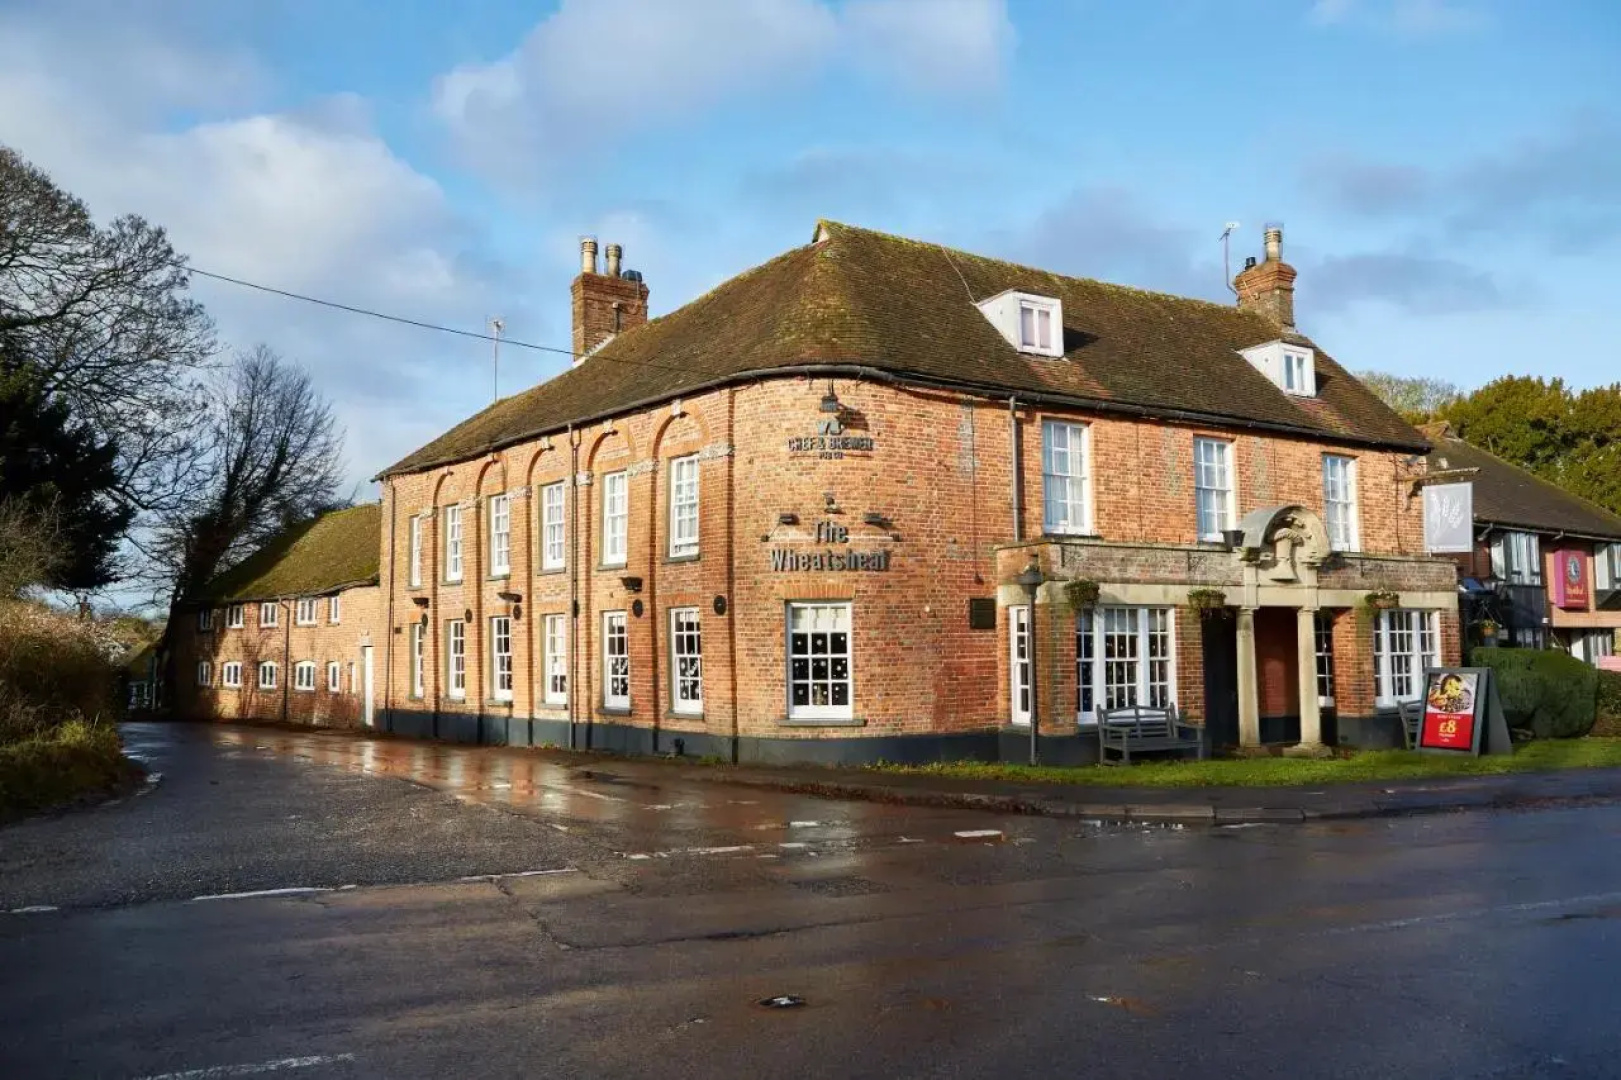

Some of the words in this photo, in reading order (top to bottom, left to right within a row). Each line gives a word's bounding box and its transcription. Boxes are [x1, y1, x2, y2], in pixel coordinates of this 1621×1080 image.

[814, 522, 849, 544] The
[771, 549, 890, 572] Wheatsheaf
[1439, 719, 1456, 733] £8
